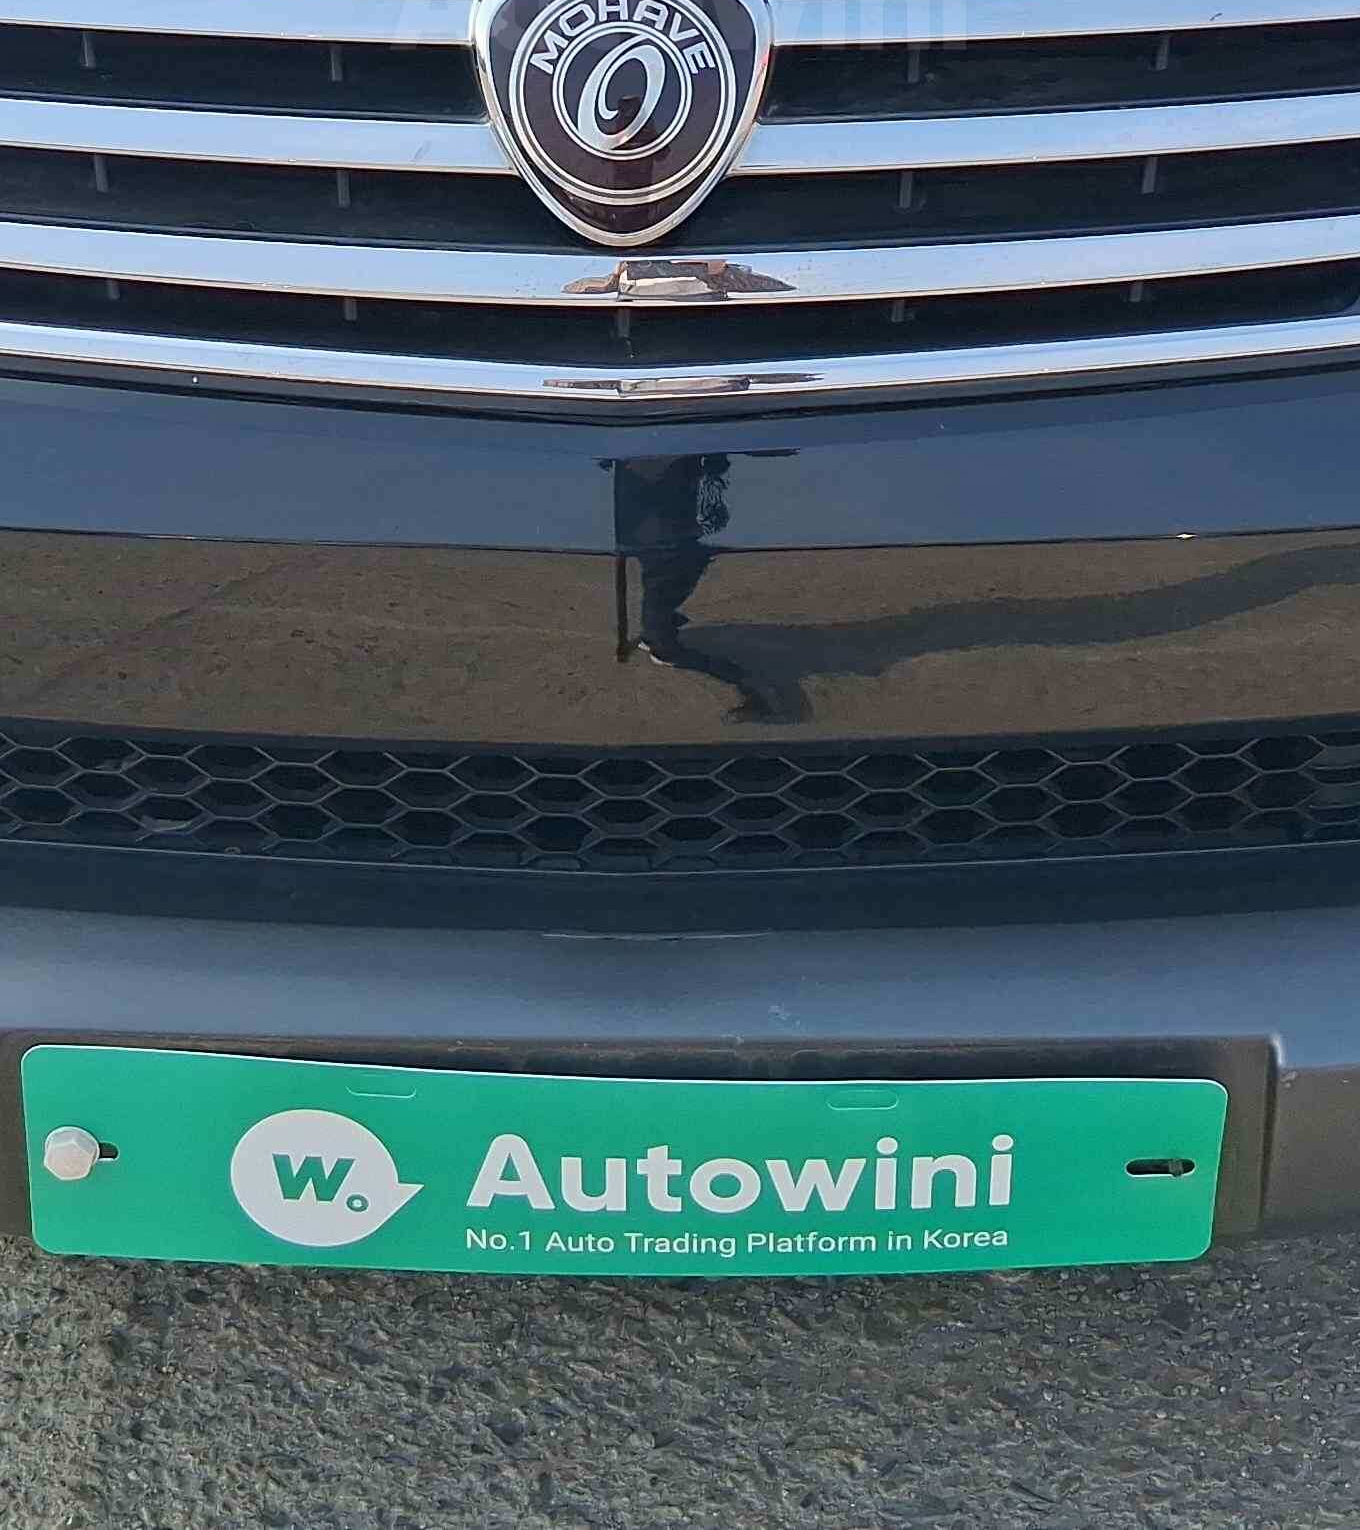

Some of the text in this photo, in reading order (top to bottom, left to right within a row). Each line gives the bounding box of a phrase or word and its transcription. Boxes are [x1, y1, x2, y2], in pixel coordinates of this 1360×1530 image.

[466, 1134, 1015, 1214] Autowini
[465, 1228, 1009, 1258] No.1 Auto Trading Platform in Korea
